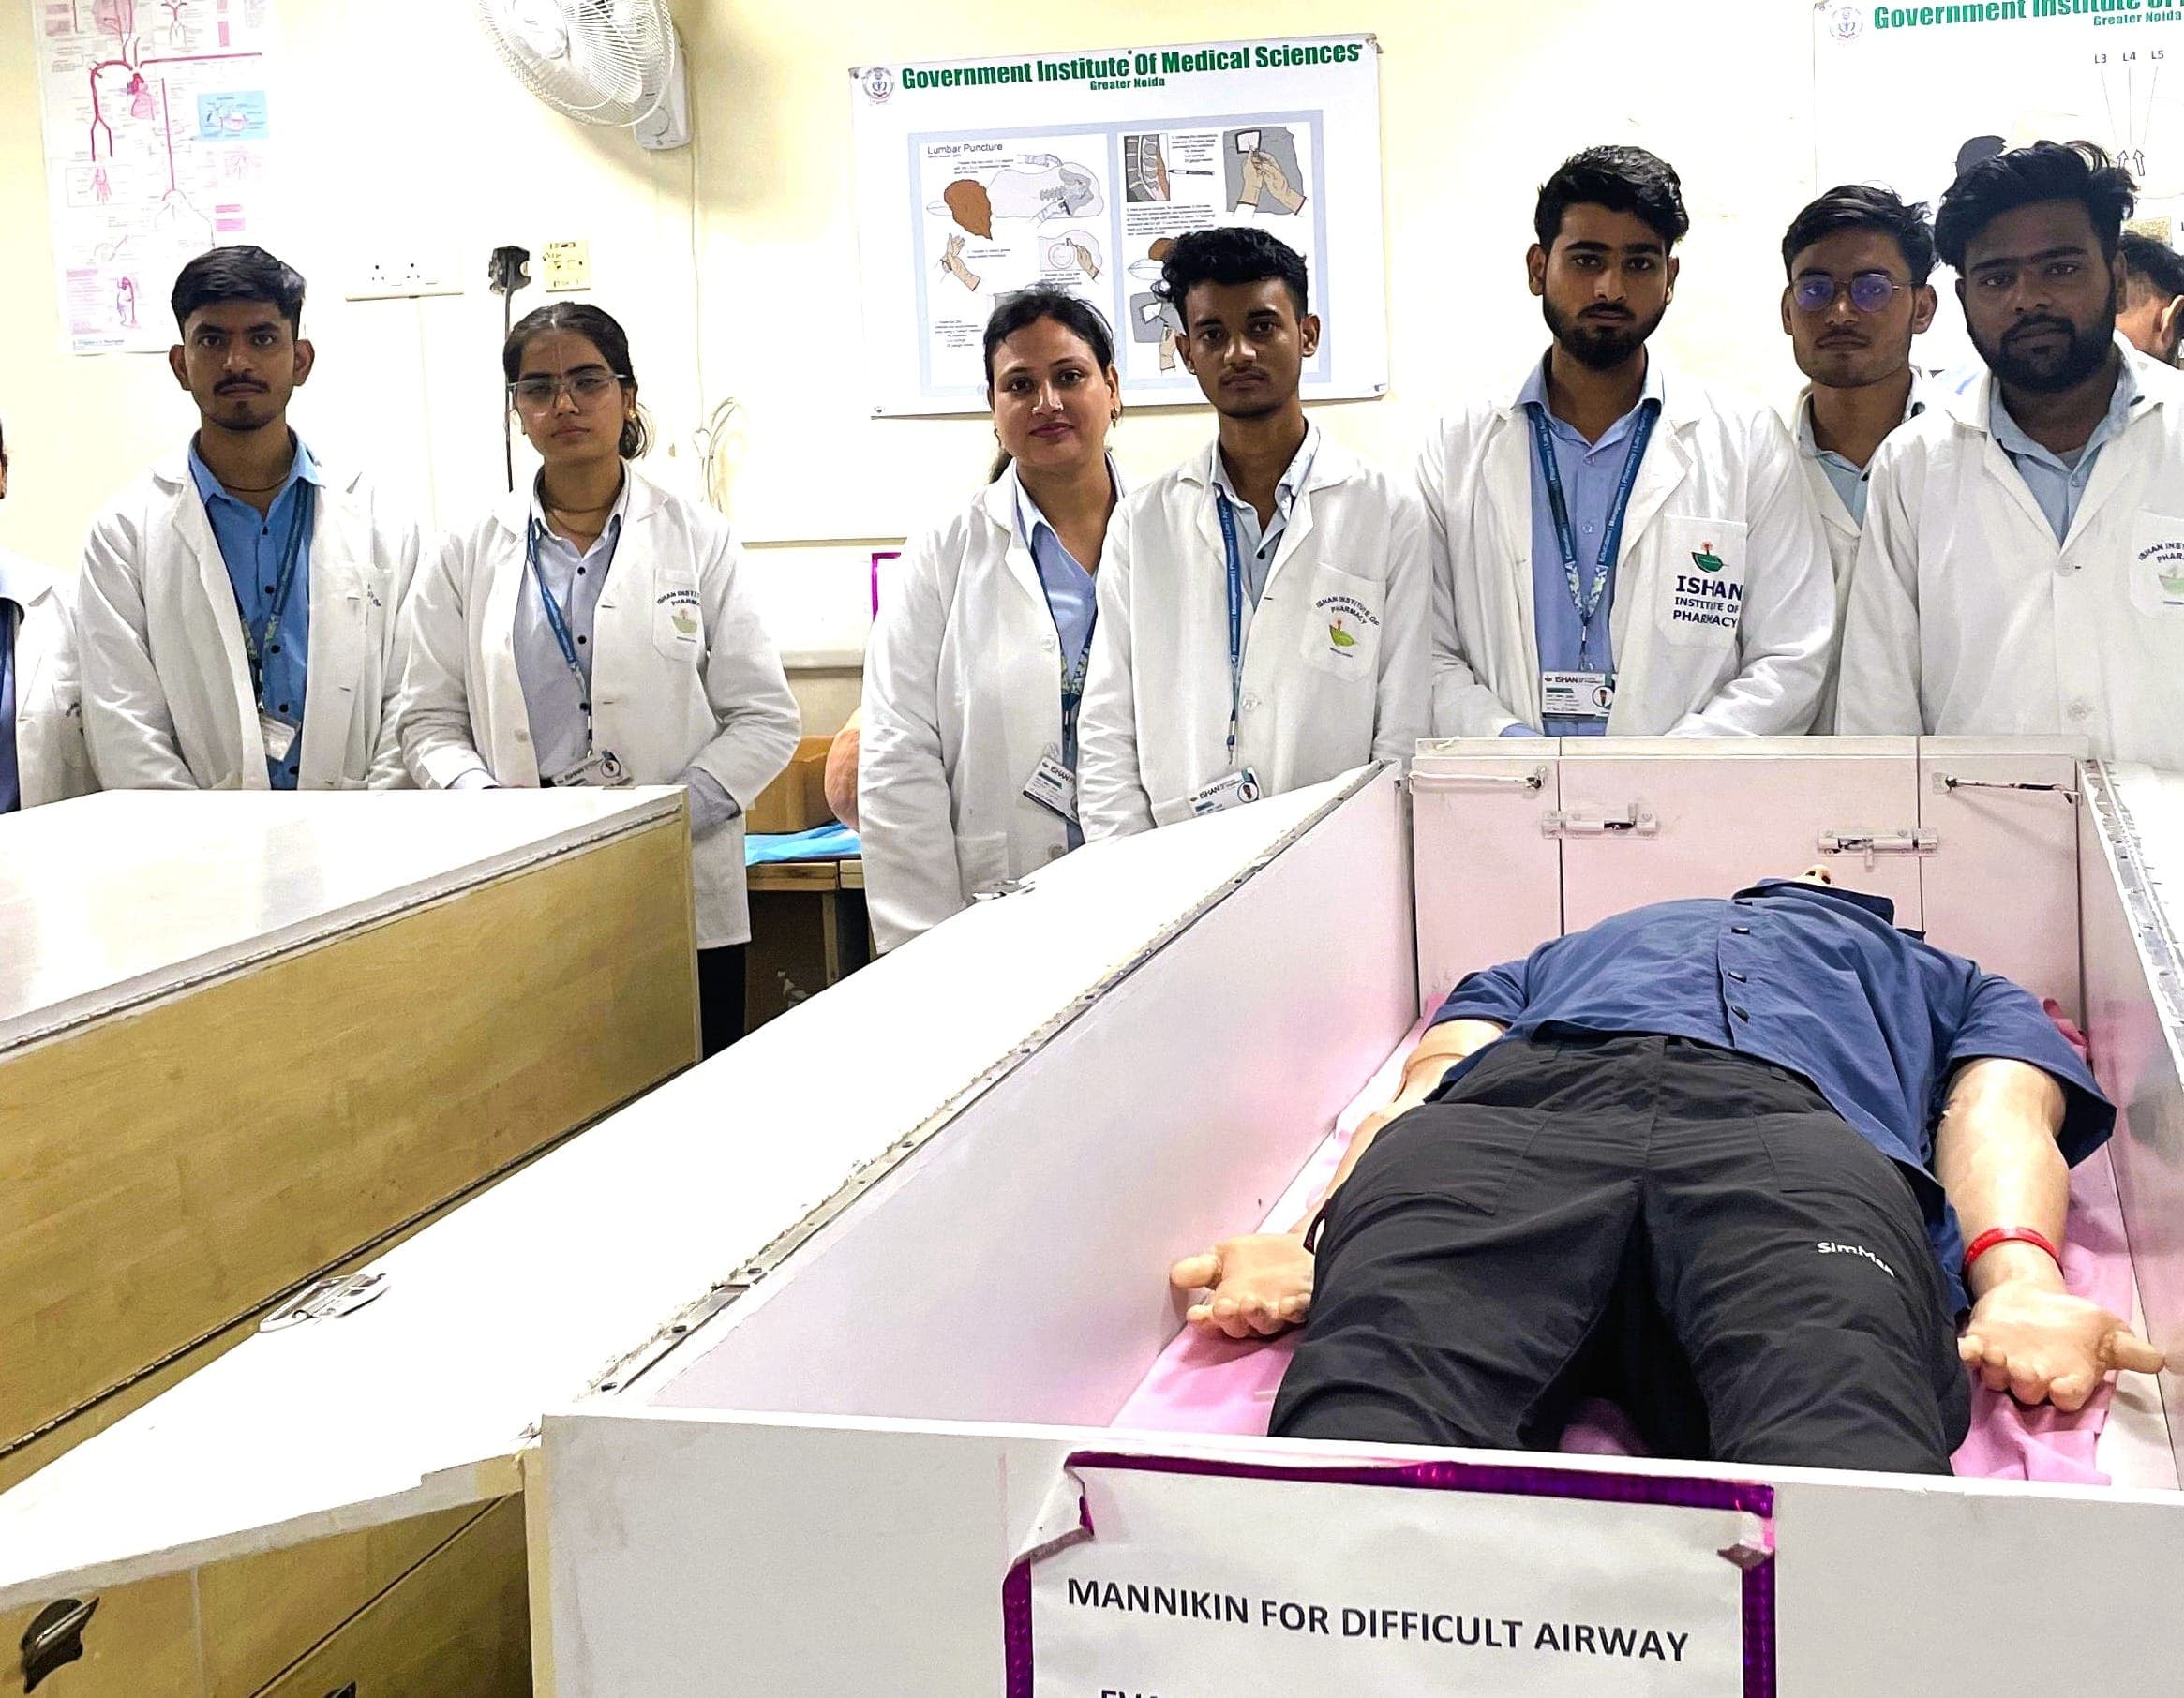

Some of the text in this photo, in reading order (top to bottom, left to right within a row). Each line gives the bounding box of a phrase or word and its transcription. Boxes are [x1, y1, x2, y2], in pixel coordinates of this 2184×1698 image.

[1874, 0, 2027, 29] Government
[2093, 10, 2182, 26] Greater Noida
[2094, 53, 2107, 64] L3
[2122, 52, 2136, 62] L4
[2151, 50, 2164, 60] L5
[902, 43, 1361, 89] Government Institute Of Medical Sciences
[1089, 76, 1165, 91] Greater Noida
[927, 142, 1003, 155] Lumbar Puncture
[2157, 552, 2184, 563] PHAR
[1676, 575, 1743, 601] ISHAN
[1675, 596, 1739, 614] INSTITUTE OF
[1672, 609, 1738, 628] PHARMACY
[1068, 1578, 1688, 1662] MANNIKIN FOR DIFFICULT AIRWAY
